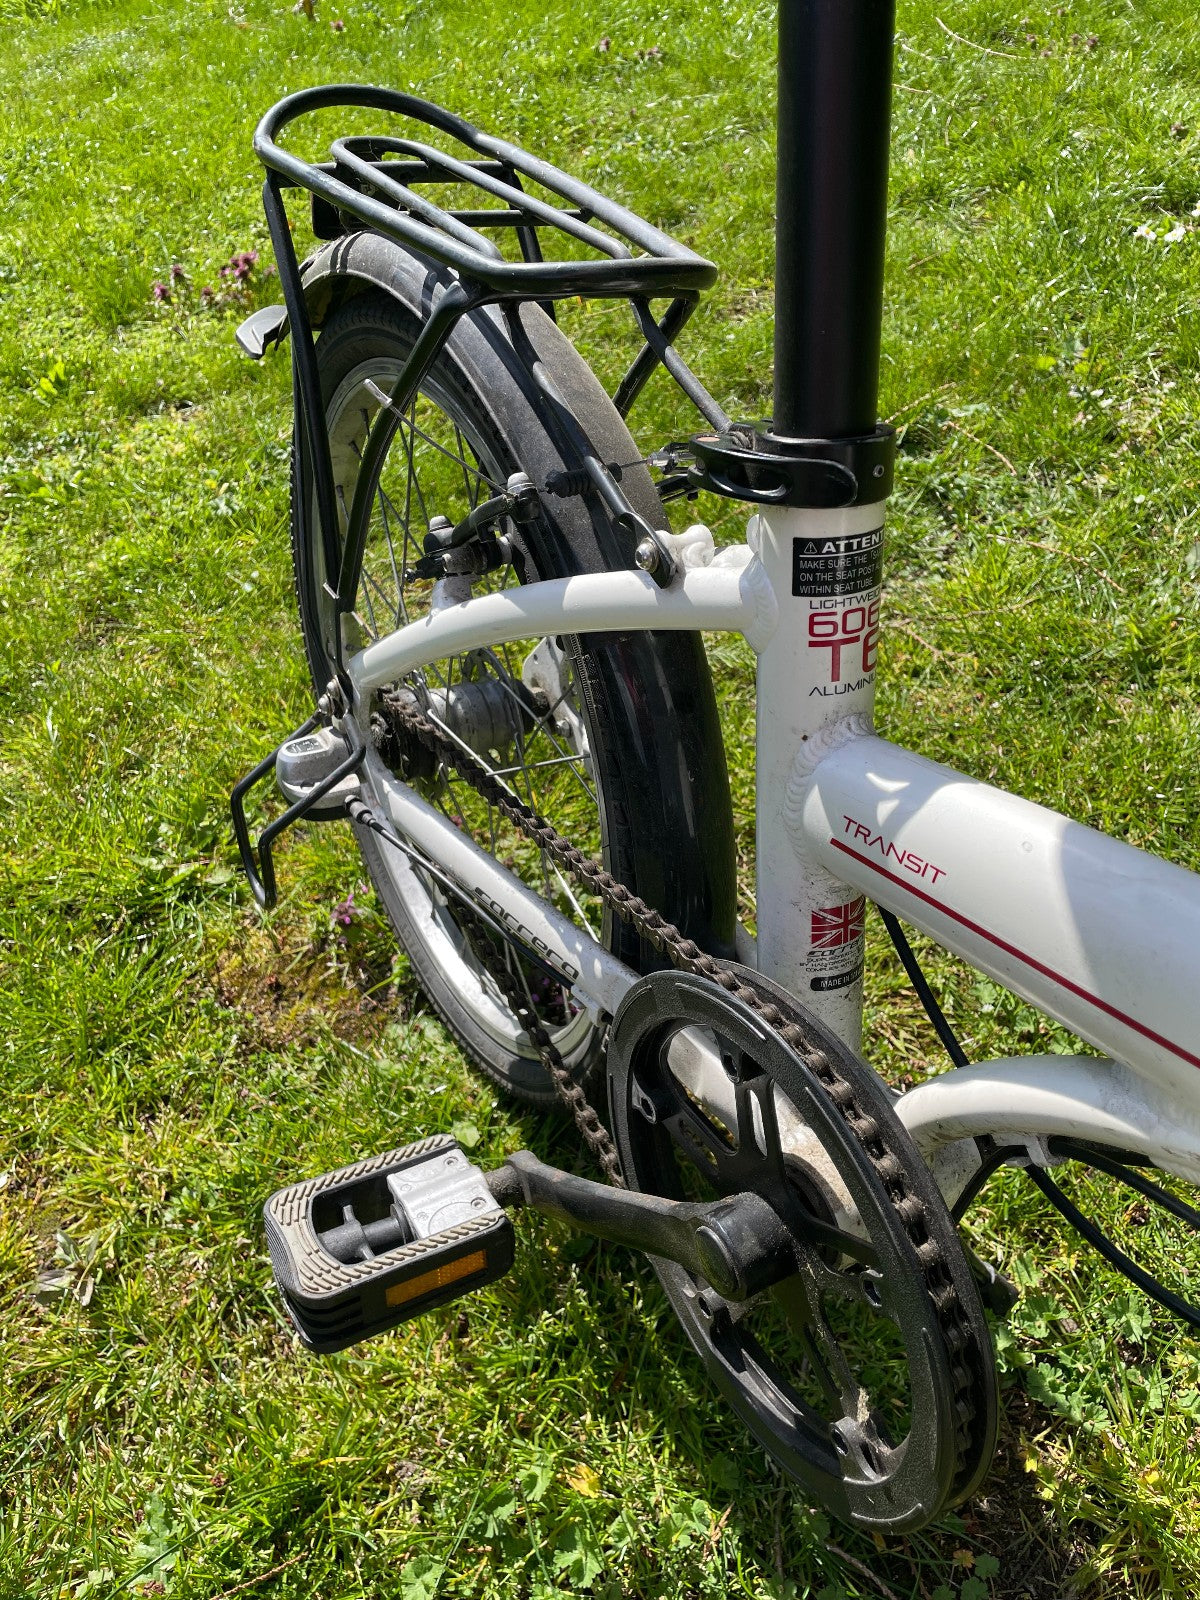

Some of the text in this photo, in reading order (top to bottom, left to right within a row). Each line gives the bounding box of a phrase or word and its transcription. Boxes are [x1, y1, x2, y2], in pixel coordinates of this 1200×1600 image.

[800, 559, 825, 570] MAKE
[827, 556, 852, 569] SURE
[854, 553, 868, 566] THE
[800, 572, 813, 582] ON
[815, 571, 833, 582] THE
[835, 569, 857, 581] SEAT
[858, 563, 875, 577] POST
[800, 576, 873, 594] WITHIN SEAT TUBE
[843, 815, 947, 884] TRANSIT
[820, 975, 850, 988] MADE IN
